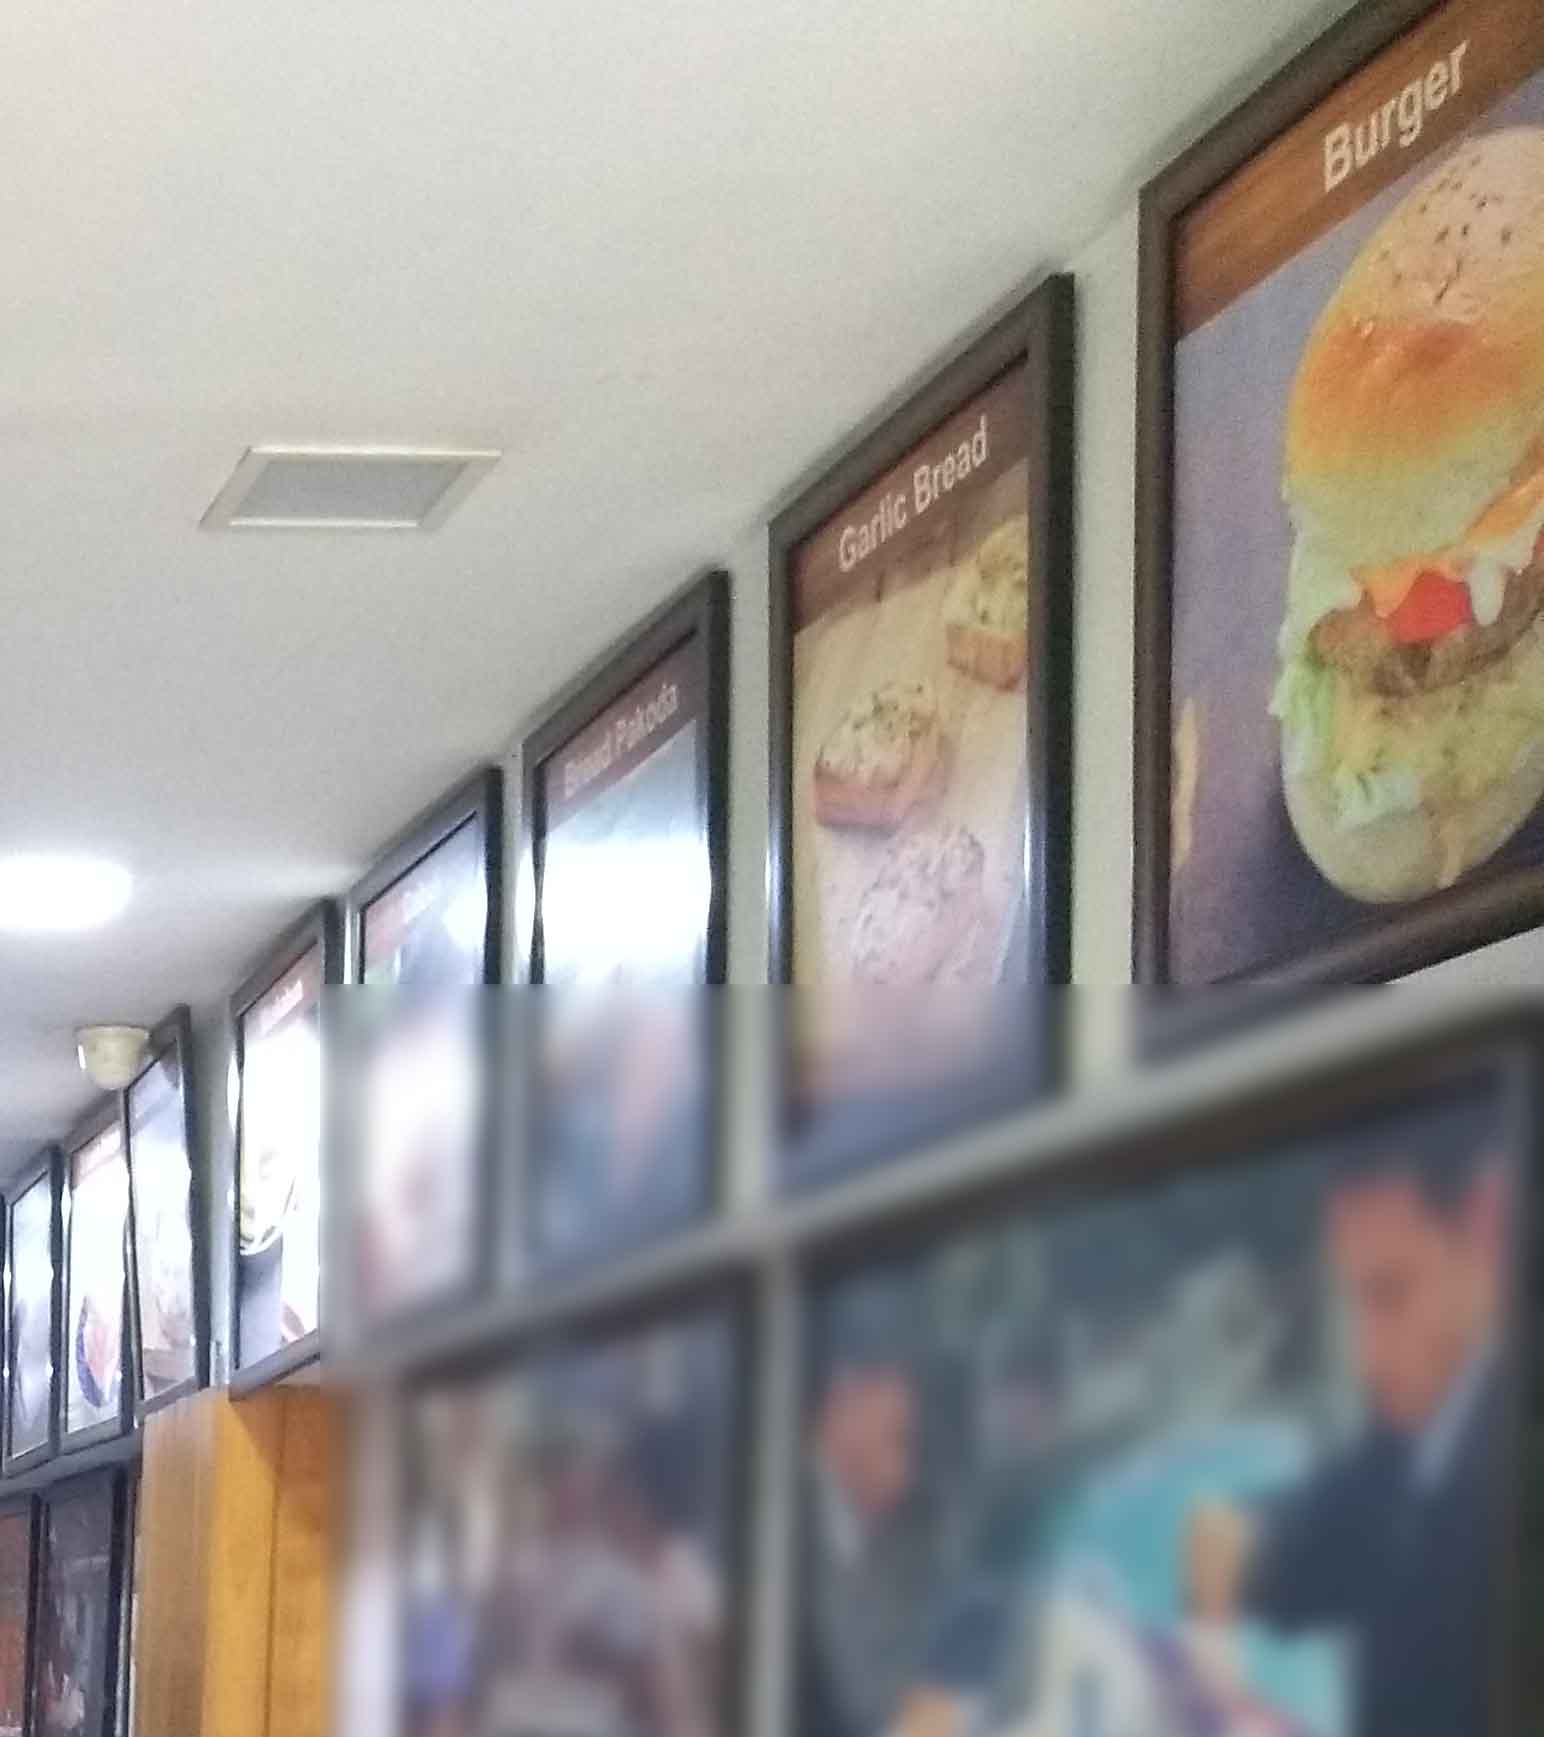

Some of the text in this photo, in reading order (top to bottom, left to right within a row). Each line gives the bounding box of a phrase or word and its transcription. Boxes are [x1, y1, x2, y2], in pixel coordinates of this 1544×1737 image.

[1324, 39, 1469, 193] Burger
[839, 414, 986, 572] Garlic Bread
